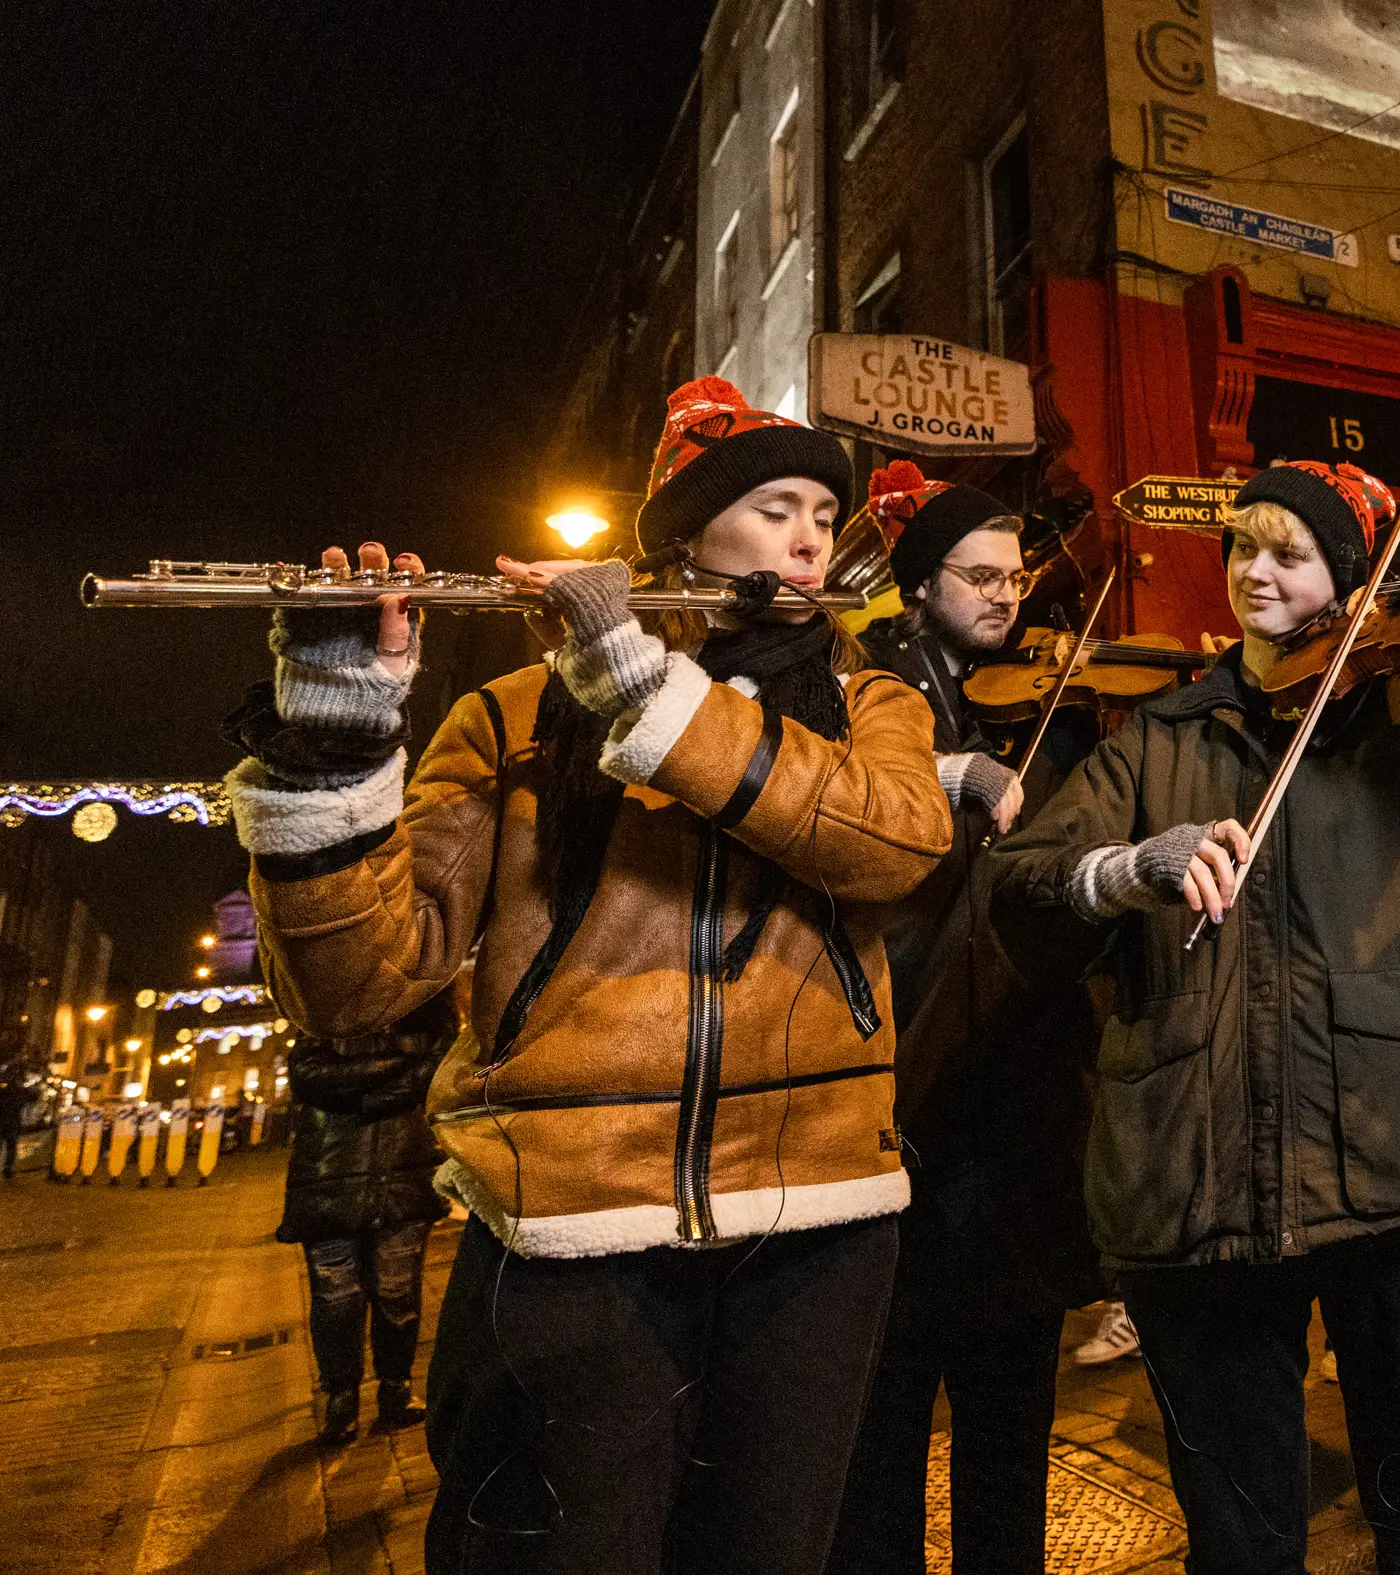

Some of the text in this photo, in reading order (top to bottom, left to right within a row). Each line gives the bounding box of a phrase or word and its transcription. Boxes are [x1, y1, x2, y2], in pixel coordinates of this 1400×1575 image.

[1137, 0, 1211, 188] GE
[1172, 193, 1233, 219] MARGADH
[1241, 212, 1259, 225] AN
[1200, 213, 1306, 250] CASTLE MARKET
[911, 337, 954, 361] THE
[861, 350, 1001, 396] CASTLE
[852, 376, 1010, 427] LOUNGE
[867, 410, 996, 442] J. GROGAN
[1328, 415, 1365, 452] 15
[1143, 484, 1171, 499] THE
[1143, 504, 1211, 522] SHOPPING
